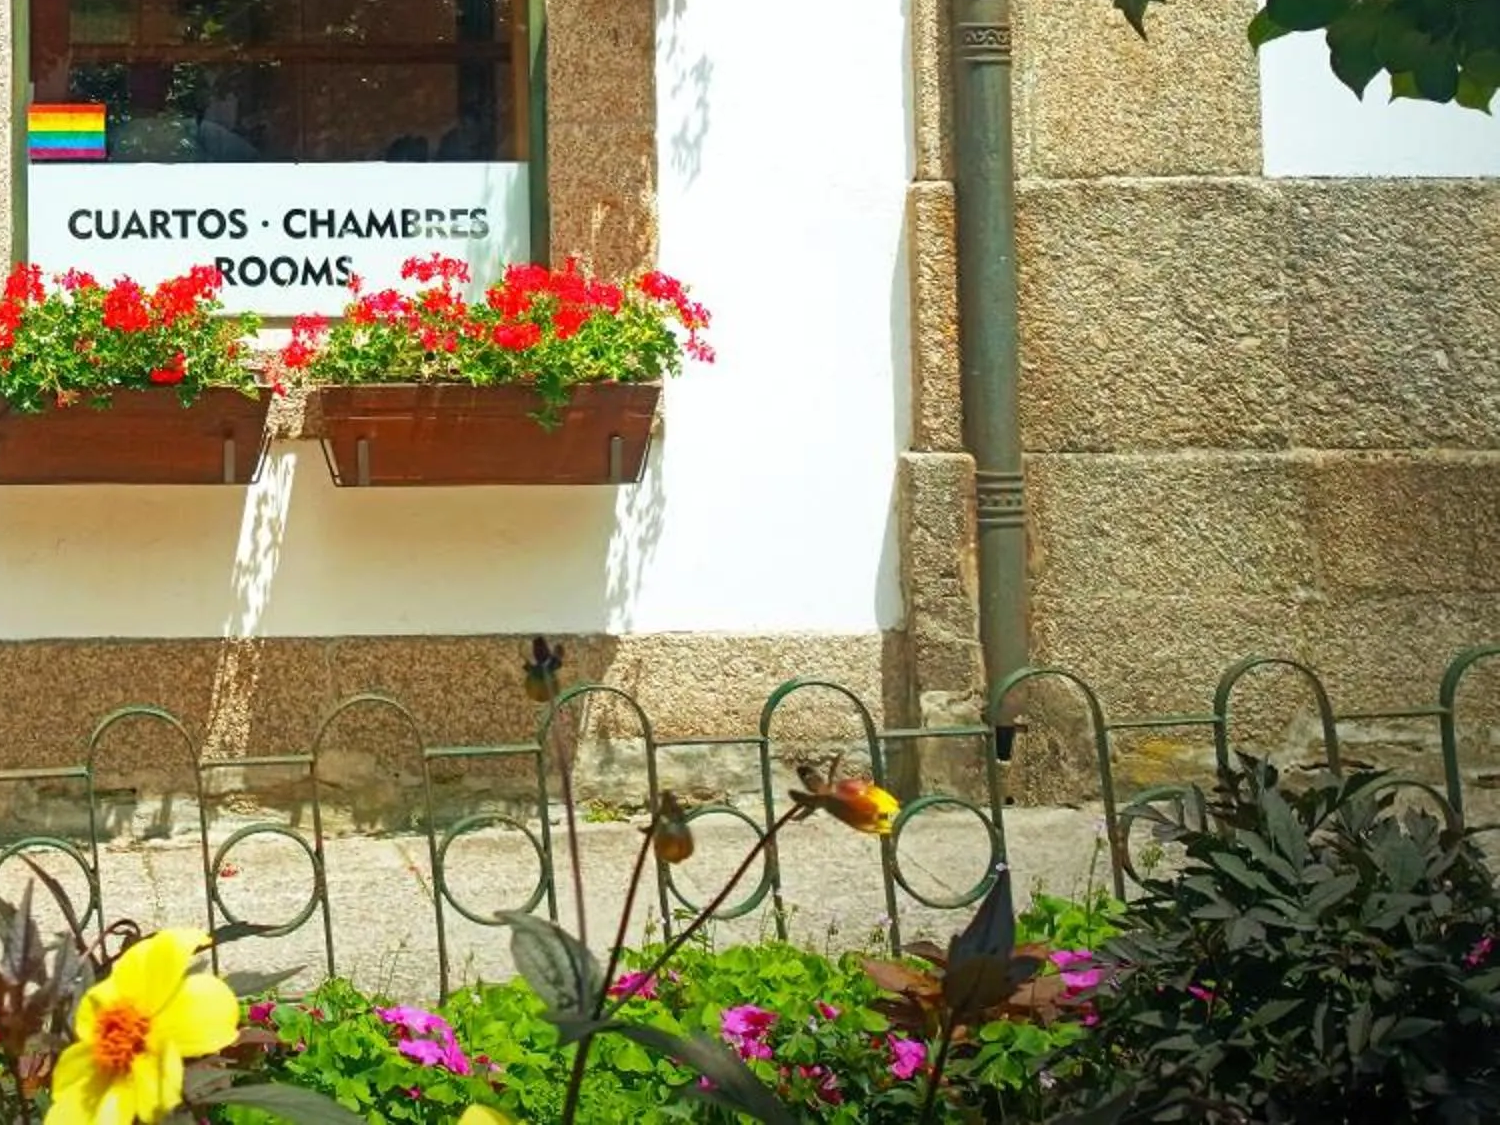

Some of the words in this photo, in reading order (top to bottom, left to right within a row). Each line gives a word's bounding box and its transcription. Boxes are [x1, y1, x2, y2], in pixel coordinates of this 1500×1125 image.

[67, 208, 248, 239] CUARTOS
[283, 208, 490, 239] CHAMBRES
[215, 255, 353, 287] ROOMS
